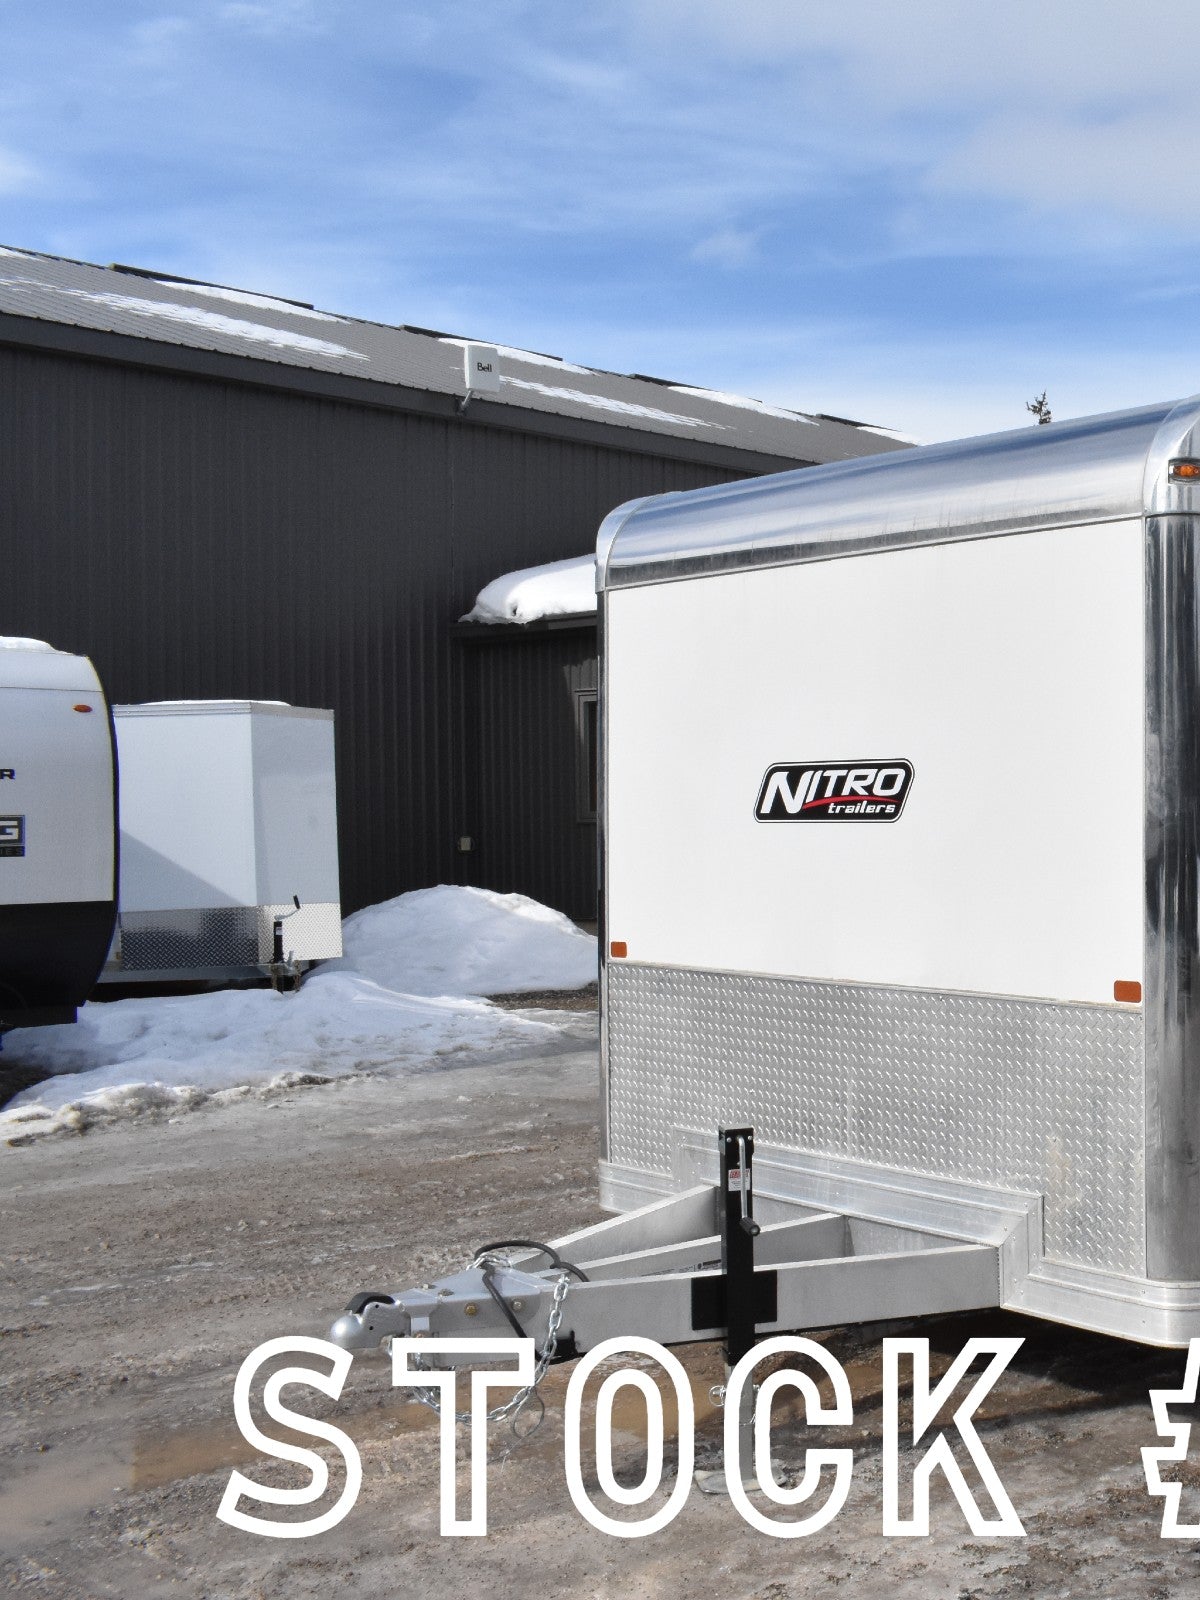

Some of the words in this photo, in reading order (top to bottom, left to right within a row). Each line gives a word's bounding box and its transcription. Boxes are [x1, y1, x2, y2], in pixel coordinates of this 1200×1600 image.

[477, 362, 492, 372] Bell
[760, 768, 906, 814] NITRO
[828, 800, 895, 814] trailers
